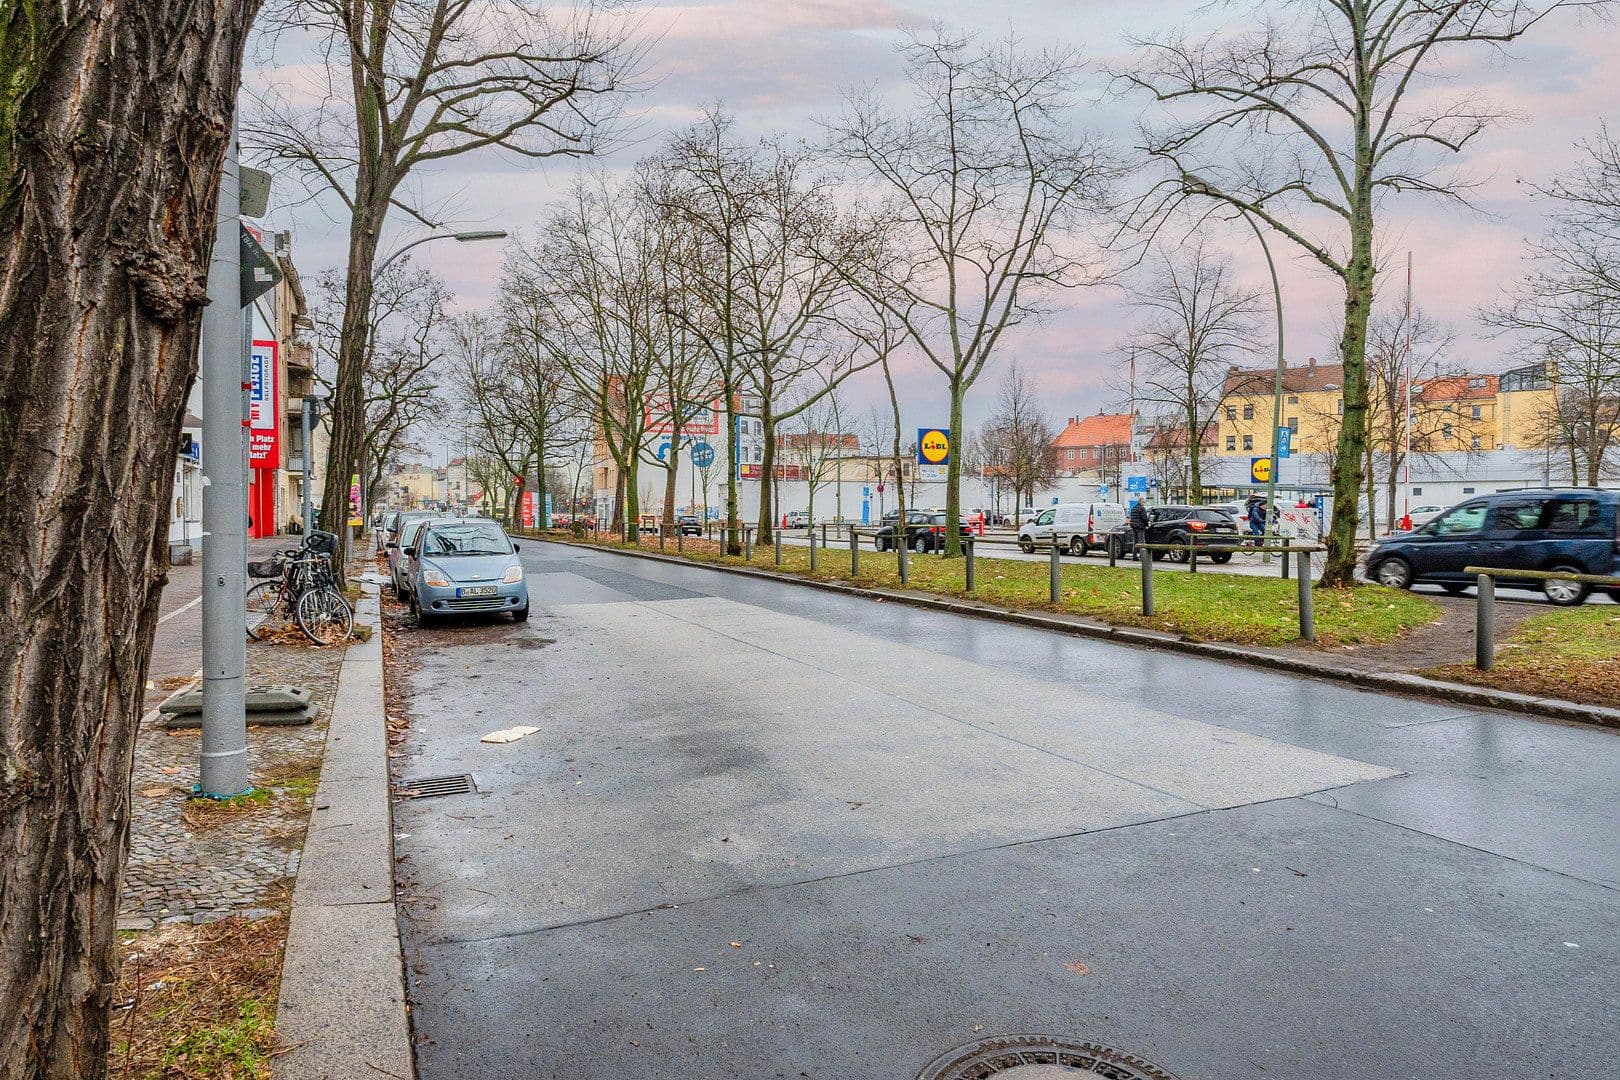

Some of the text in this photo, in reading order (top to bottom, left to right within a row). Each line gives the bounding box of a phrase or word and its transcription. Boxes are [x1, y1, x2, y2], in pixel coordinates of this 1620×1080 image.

[256, 434, 275, 443] Platz
[252, 443, 272, 451] mehr
[924, 441, 947, 450] LIDL
